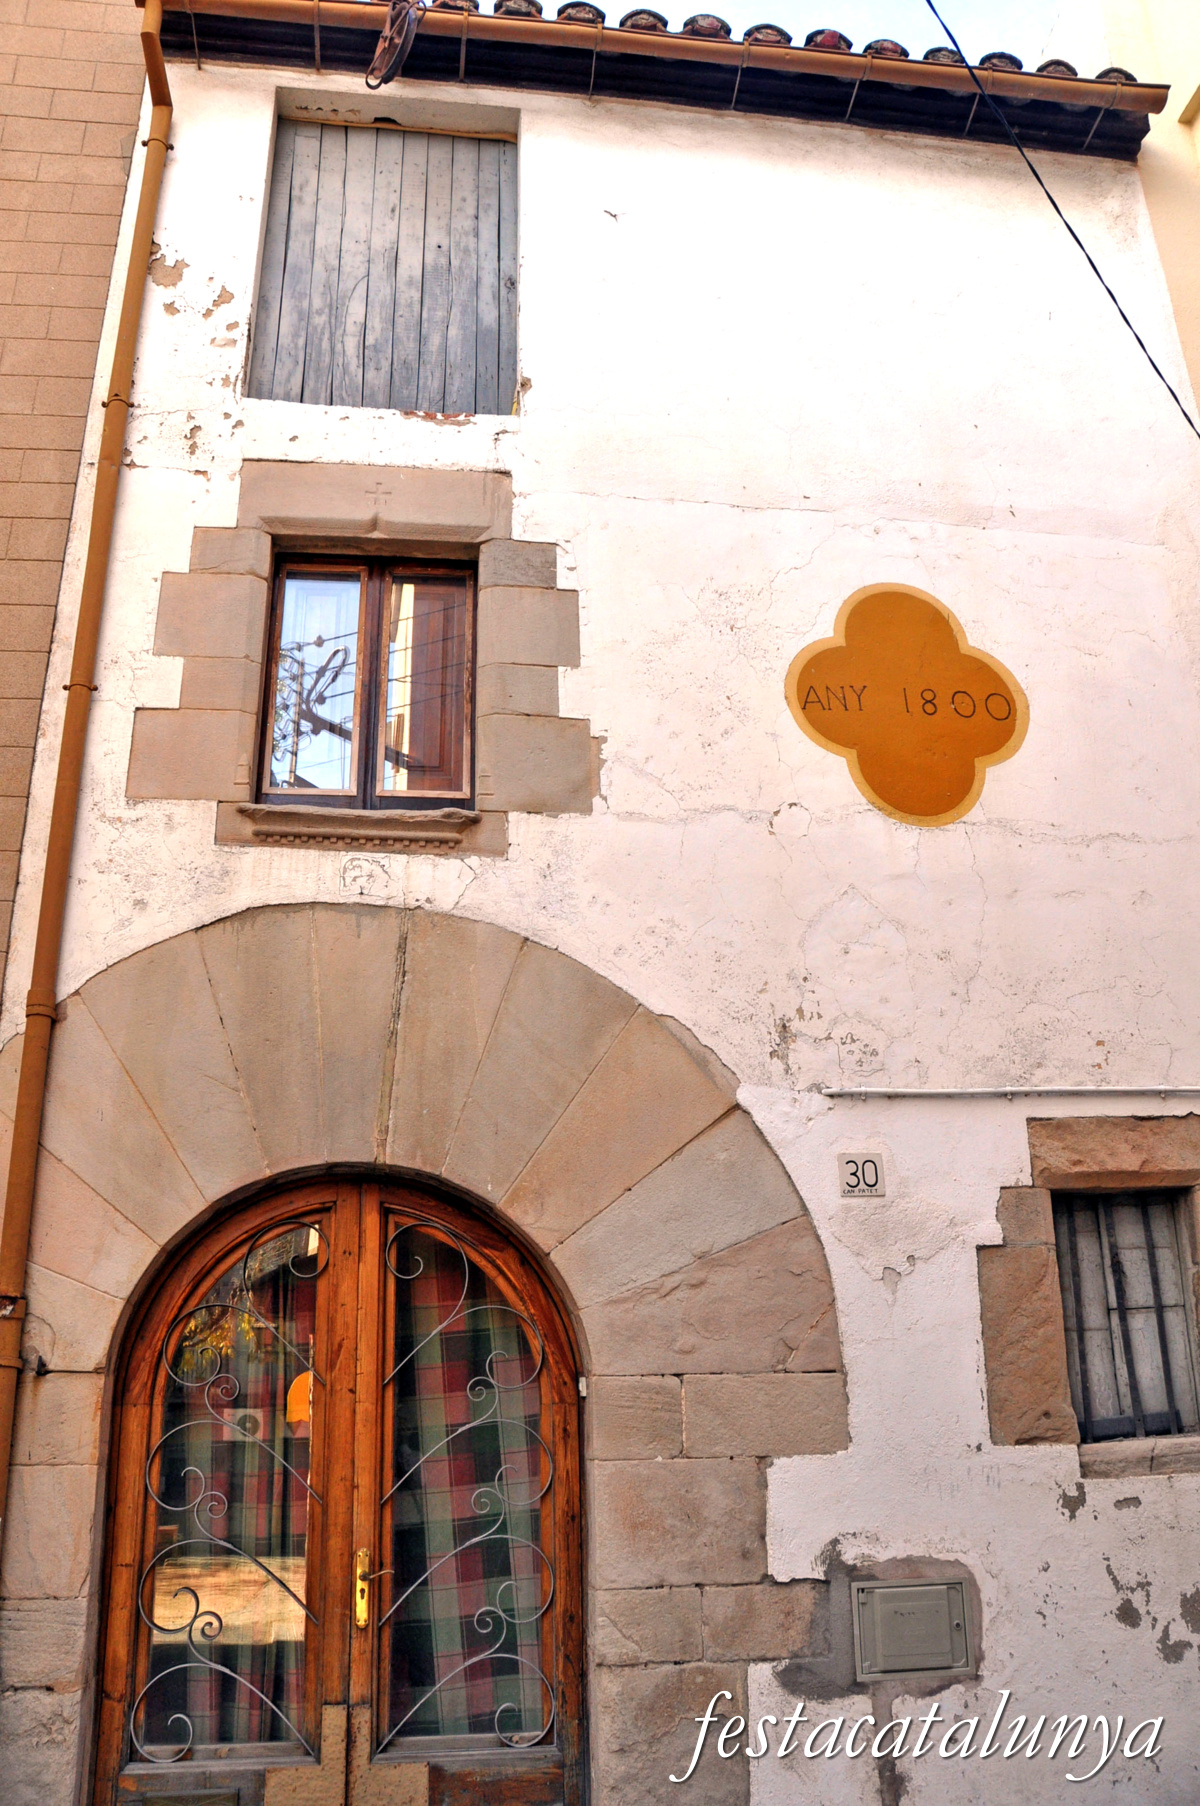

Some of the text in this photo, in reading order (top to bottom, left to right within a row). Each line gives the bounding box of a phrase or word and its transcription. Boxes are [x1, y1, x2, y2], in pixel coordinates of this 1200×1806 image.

[801, 685, 1011, 721] ANY 1800
[845, 1159, 878, 1188] 30
